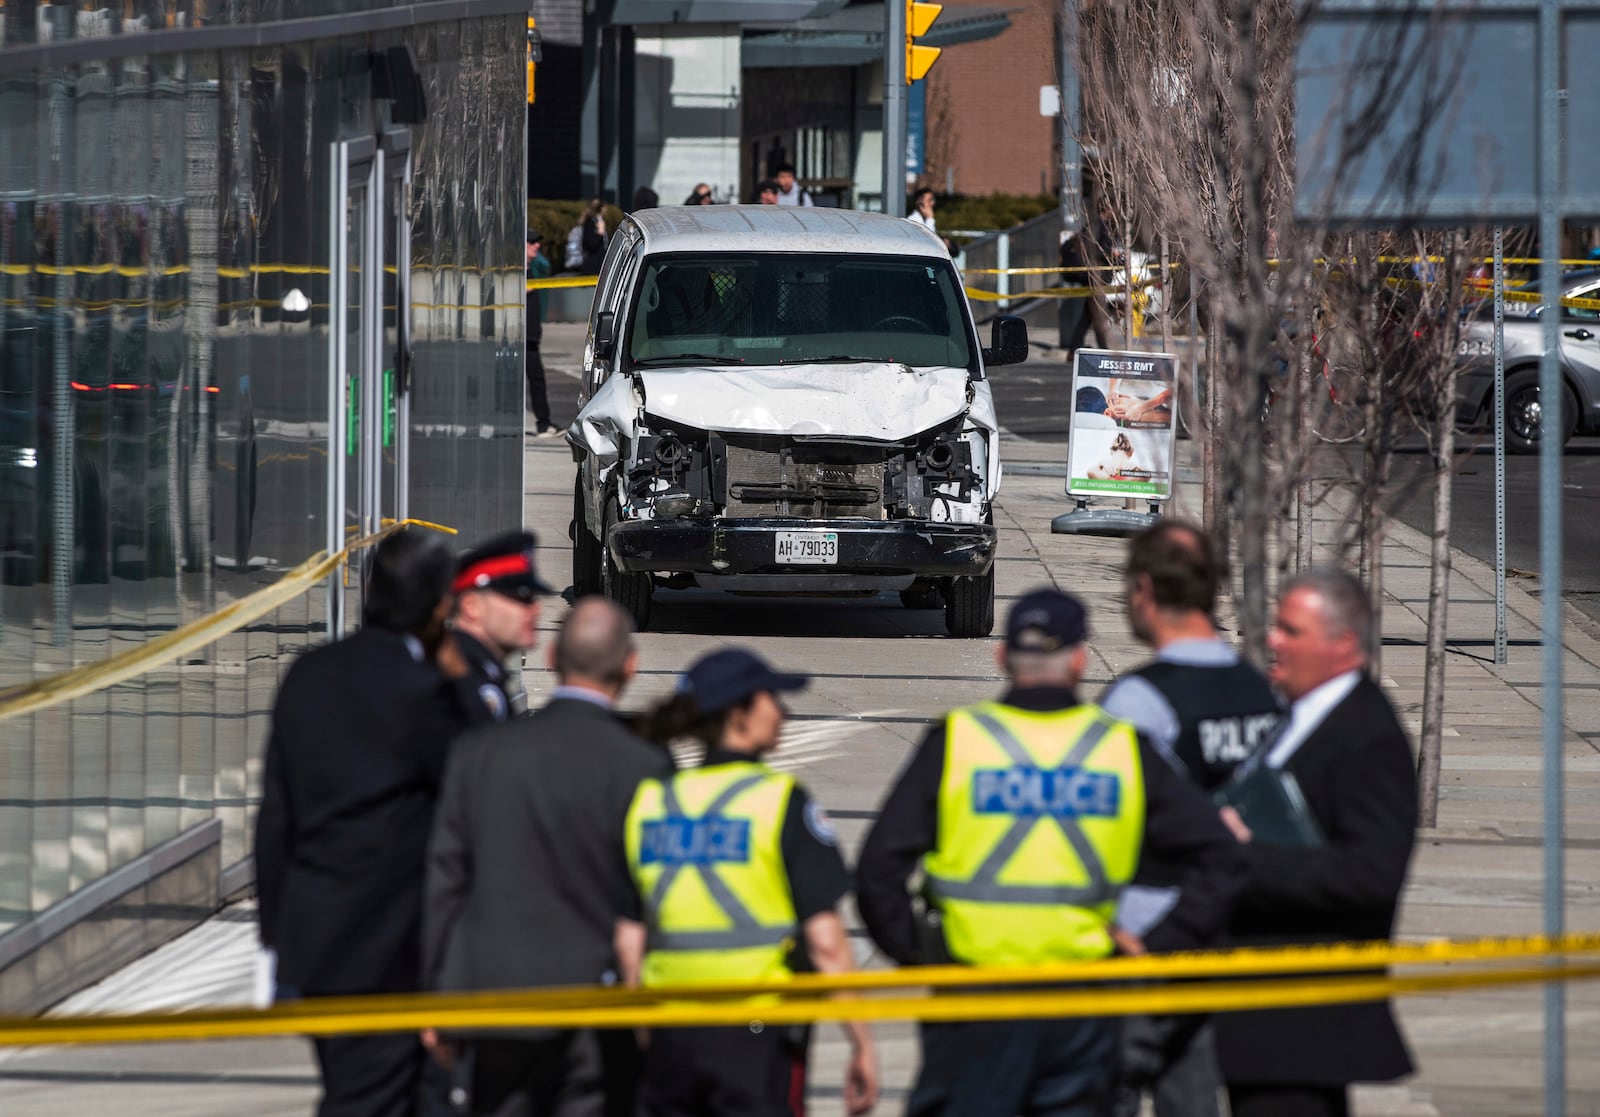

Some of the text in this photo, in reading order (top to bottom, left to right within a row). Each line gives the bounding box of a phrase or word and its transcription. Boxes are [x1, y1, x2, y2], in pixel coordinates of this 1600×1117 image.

[1460, 340, 1495, 356] 325
[1098, 360, 1154, 372] JESSE'S RMT
[778, 540, 835, 556] AH 79033
[978, 771, 1113, 812] POLICE
